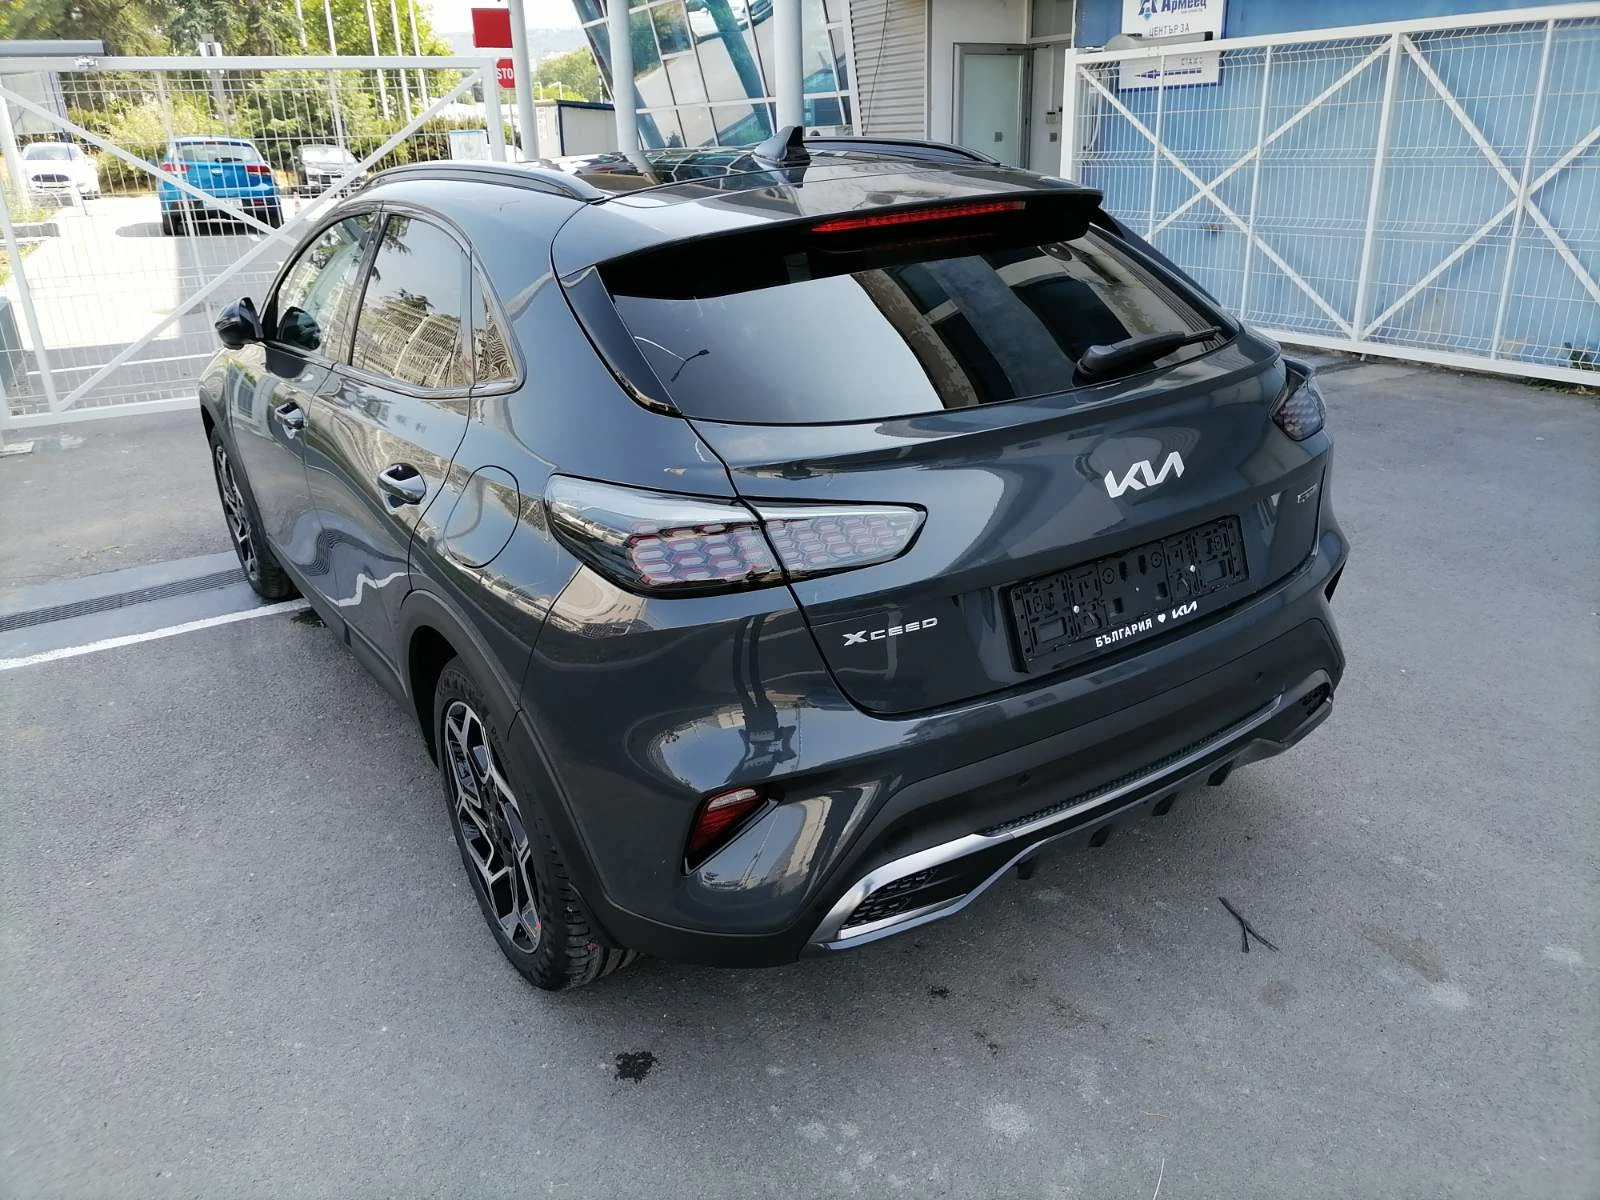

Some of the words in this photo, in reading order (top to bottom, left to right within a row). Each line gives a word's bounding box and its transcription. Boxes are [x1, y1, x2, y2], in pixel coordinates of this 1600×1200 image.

[1180, 23, 1190, 33] ЗА
[497, 67, 513, 79] STO
[1104, 451, 1185, 499] KIA
[842, 617, 938, 646] XCEED
[1095, 618, 1153, 648] БЪЛГАРИЯ
[1171, 600, 1198, 619] KIA
